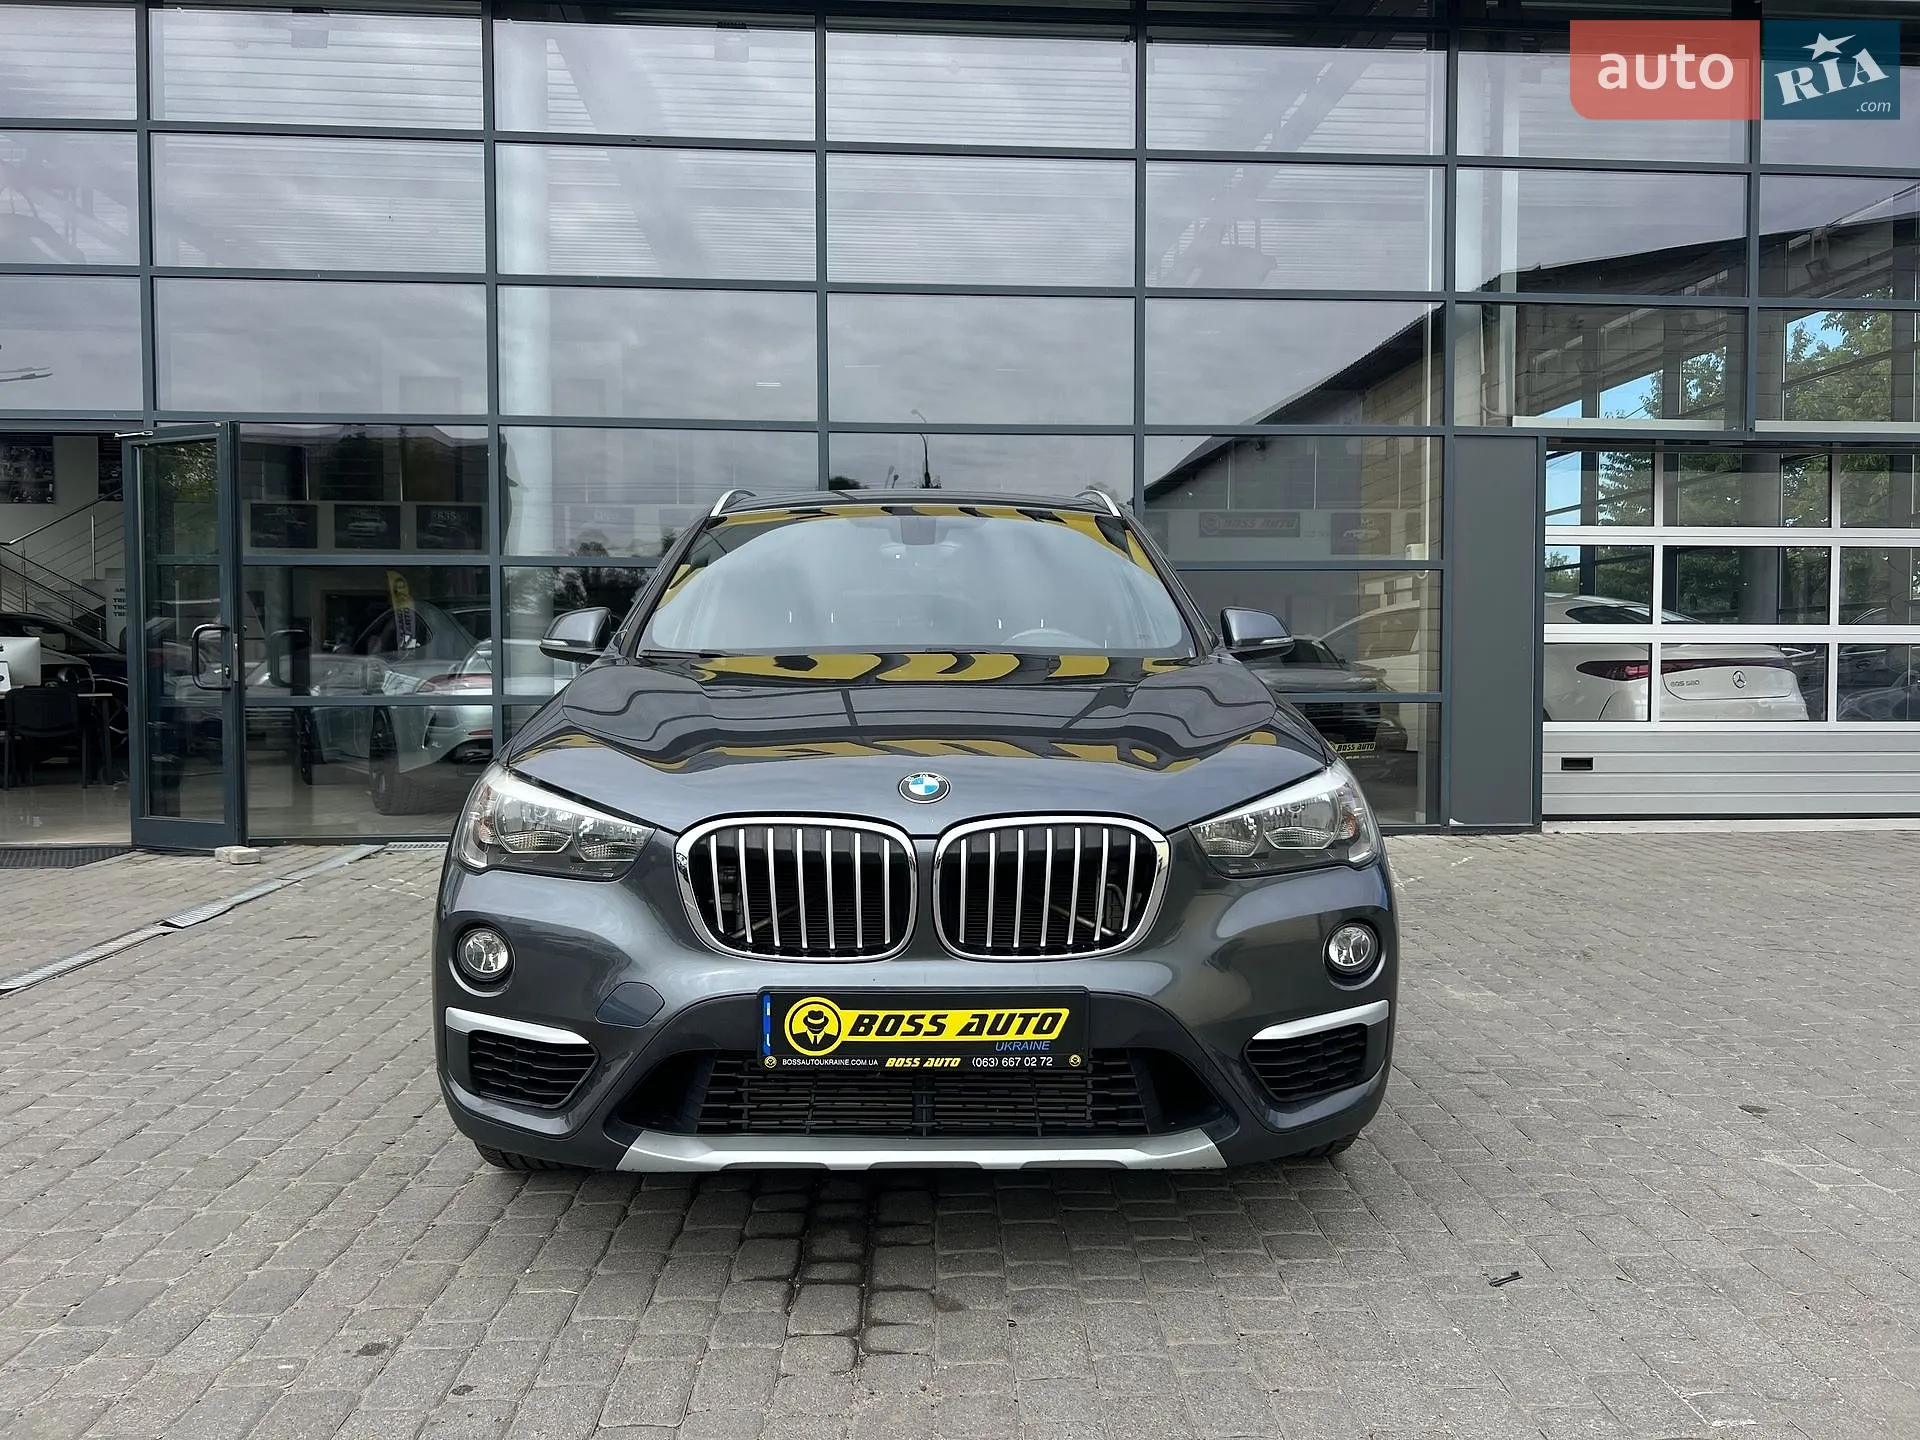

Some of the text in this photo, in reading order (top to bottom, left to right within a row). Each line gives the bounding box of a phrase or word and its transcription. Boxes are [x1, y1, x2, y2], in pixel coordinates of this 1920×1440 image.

[1337, 743, 1375, 752] BOSS AUTO
[847, 1012, 1063, 1037] BOSS AUTO
[995, 1040, 1051, 1052] UKRAINE
[782, 1057, 1053, 1068] BOSSAUTOUKRAINE.COM.UA BOSS AUTO (063) 667 02 72
